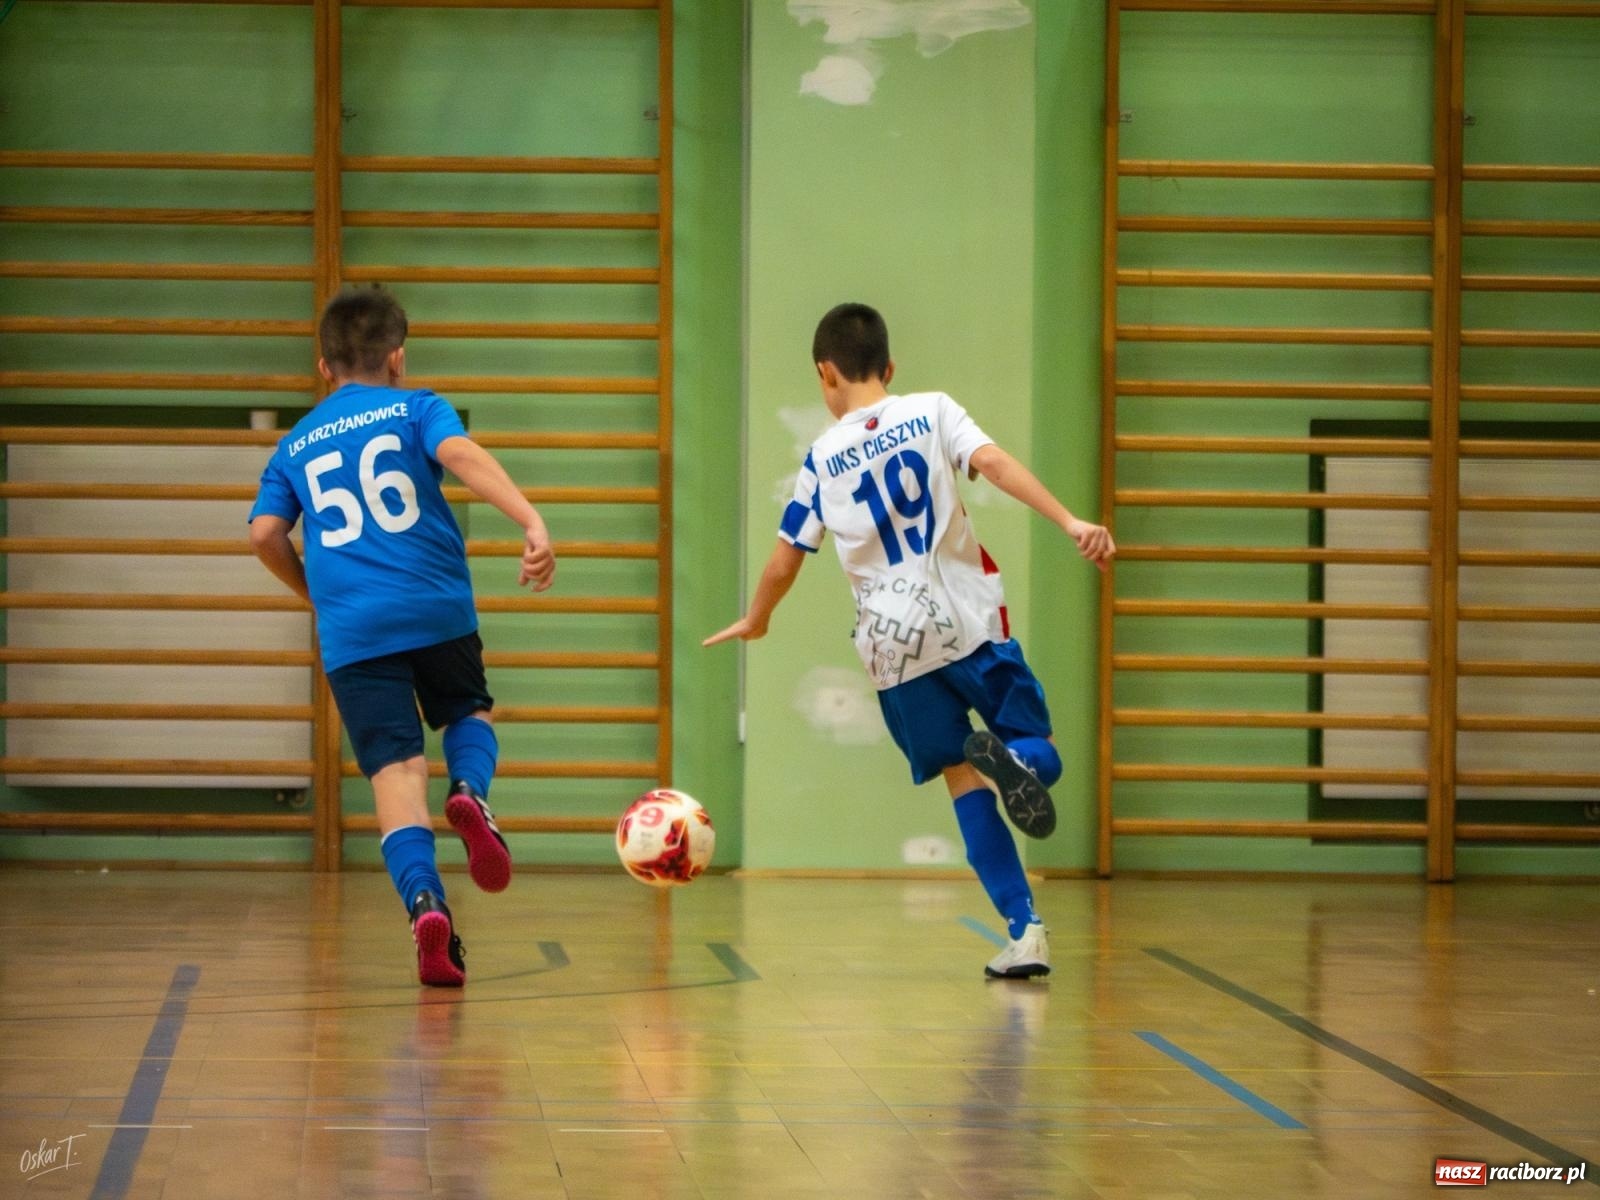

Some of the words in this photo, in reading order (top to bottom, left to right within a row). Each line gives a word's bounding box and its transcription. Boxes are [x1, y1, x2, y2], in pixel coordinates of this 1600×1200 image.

[288, 436, 306, 457] LKS
[307, 402, 408, 445] KRZYŻANOWICE
[826, 447, 861, 478] UKS
[863, 415, 931, 461] CIESZYN
[304, 434, 420, 548] 56
[852, 450, 936, 567] 19
